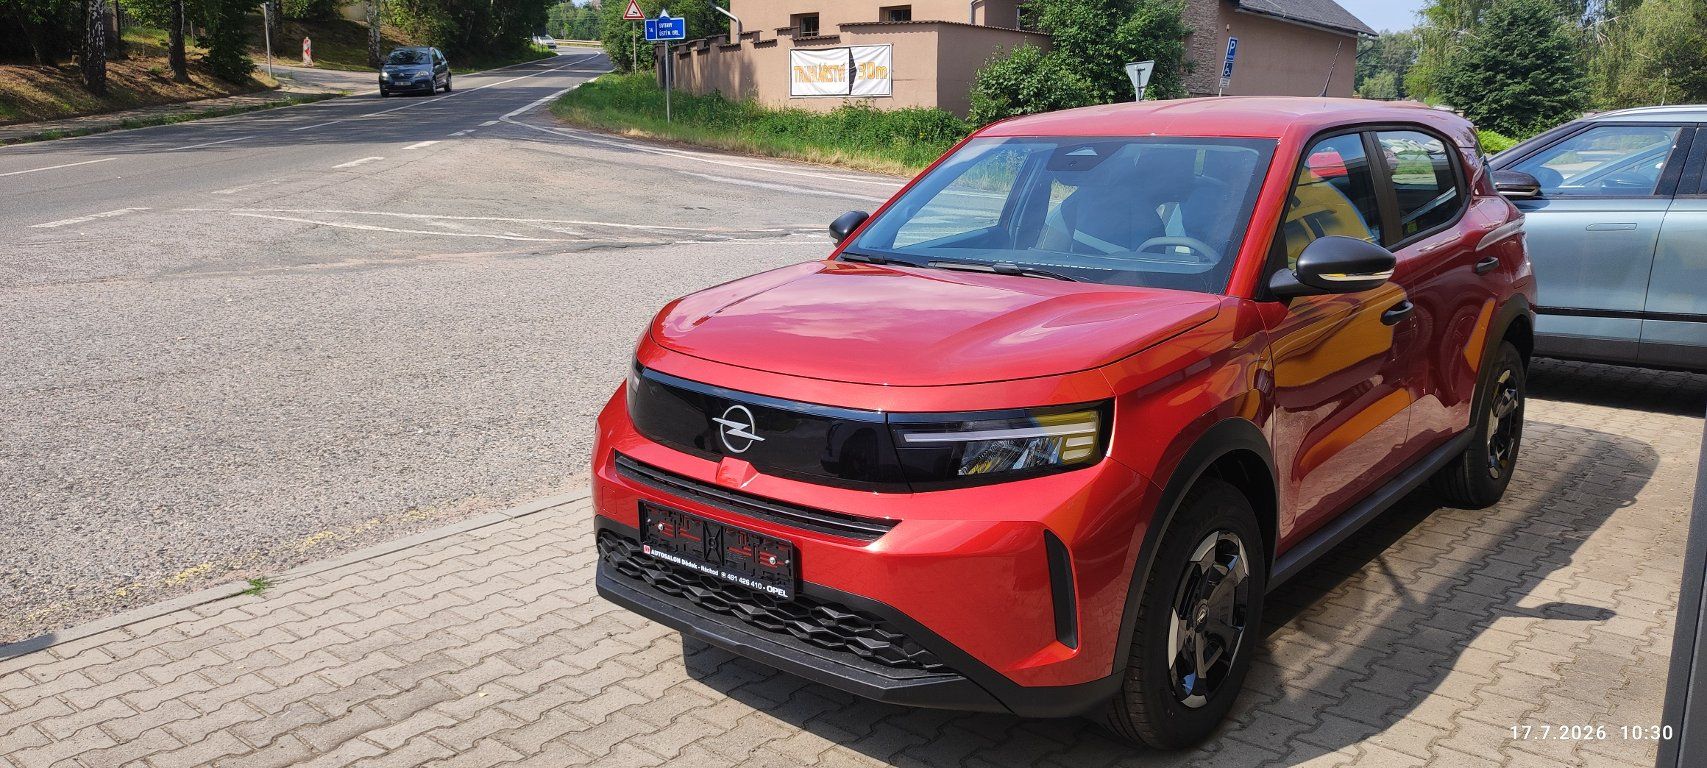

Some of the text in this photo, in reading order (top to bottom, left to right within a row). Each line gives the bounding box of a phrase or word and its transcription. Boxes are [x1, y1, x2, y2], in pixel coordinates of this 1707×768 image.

[1229, 40, 1236, 54] P
[651, 549, 681, 564] AUTOSALON
[750, 581, 763, 590] 410
[766, 585, 788, 598] OPEL
